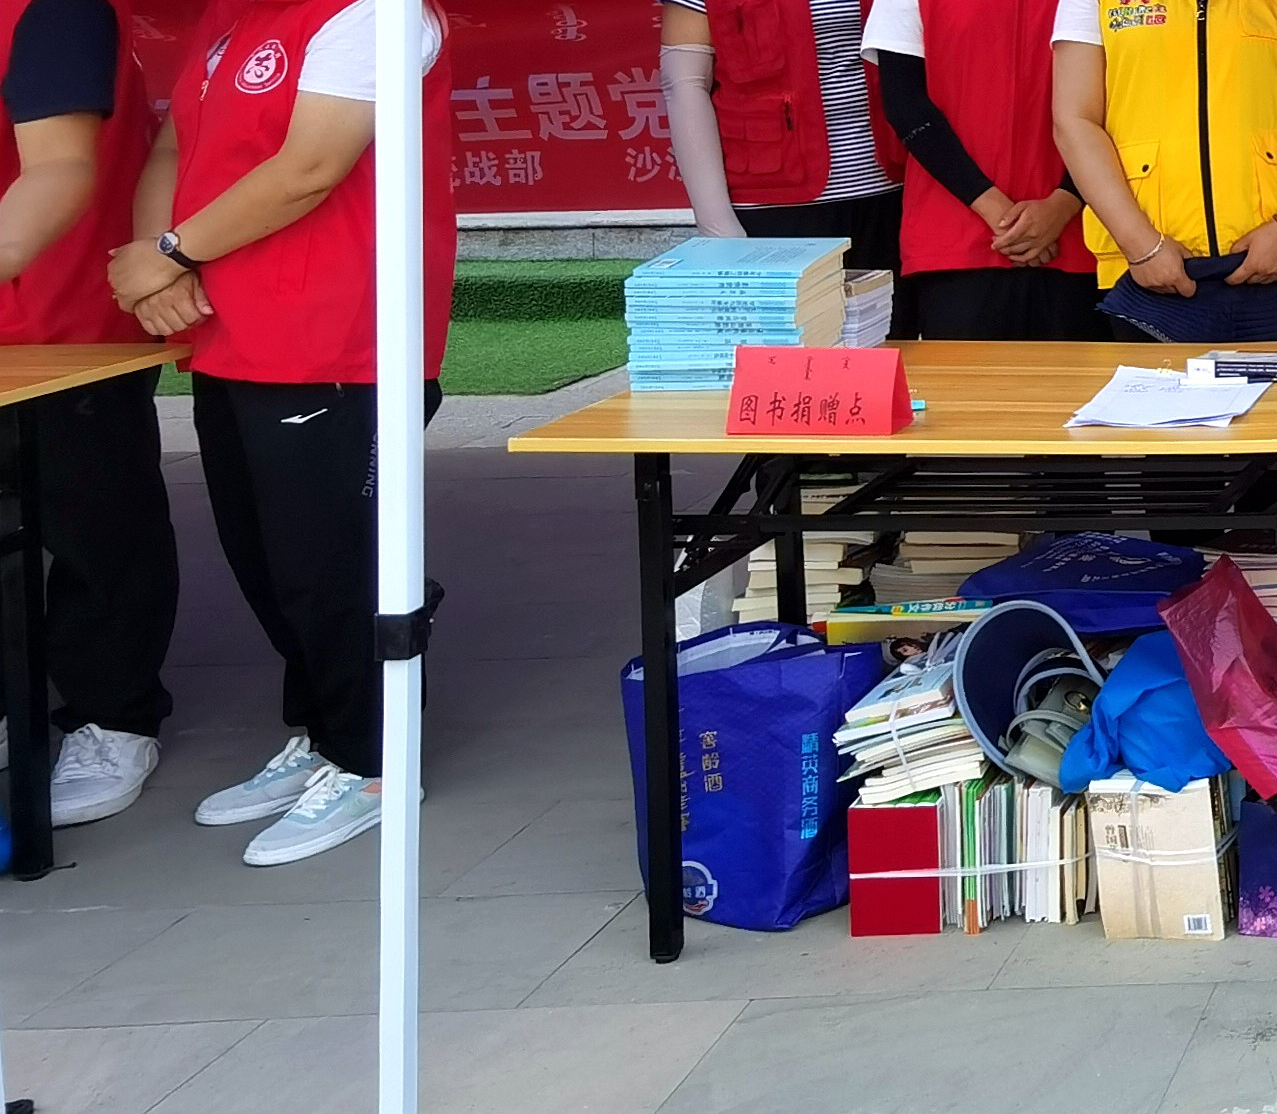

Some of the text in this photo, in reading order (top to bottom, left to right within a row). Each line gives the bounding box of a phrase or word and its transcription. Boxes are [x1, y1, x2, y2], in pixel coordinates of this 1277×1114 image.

[738, 391, 867, 427] 图书捐赠点
[699, 730, 724, 793] 窖龄酒
[800, 732, 820, 840] 精英商务酒
